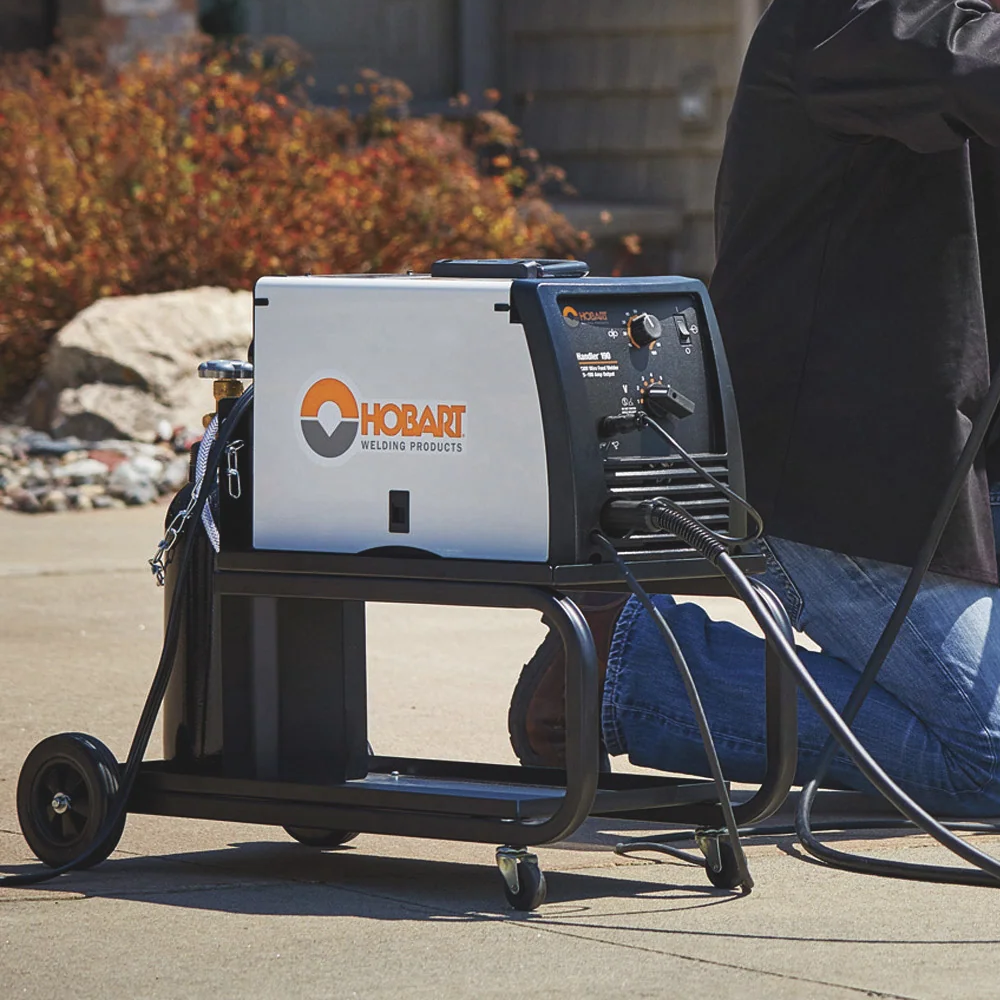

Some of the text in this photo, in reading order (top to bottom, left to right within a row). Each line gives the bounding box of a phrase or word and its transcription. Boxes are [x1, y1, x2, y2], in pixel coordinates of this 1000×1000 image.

[579, 311, 608, 320] HOBART
[361, 403, 466, 438] HOBART
[361, 440, 463, 452] WELDING PRODUCTS
